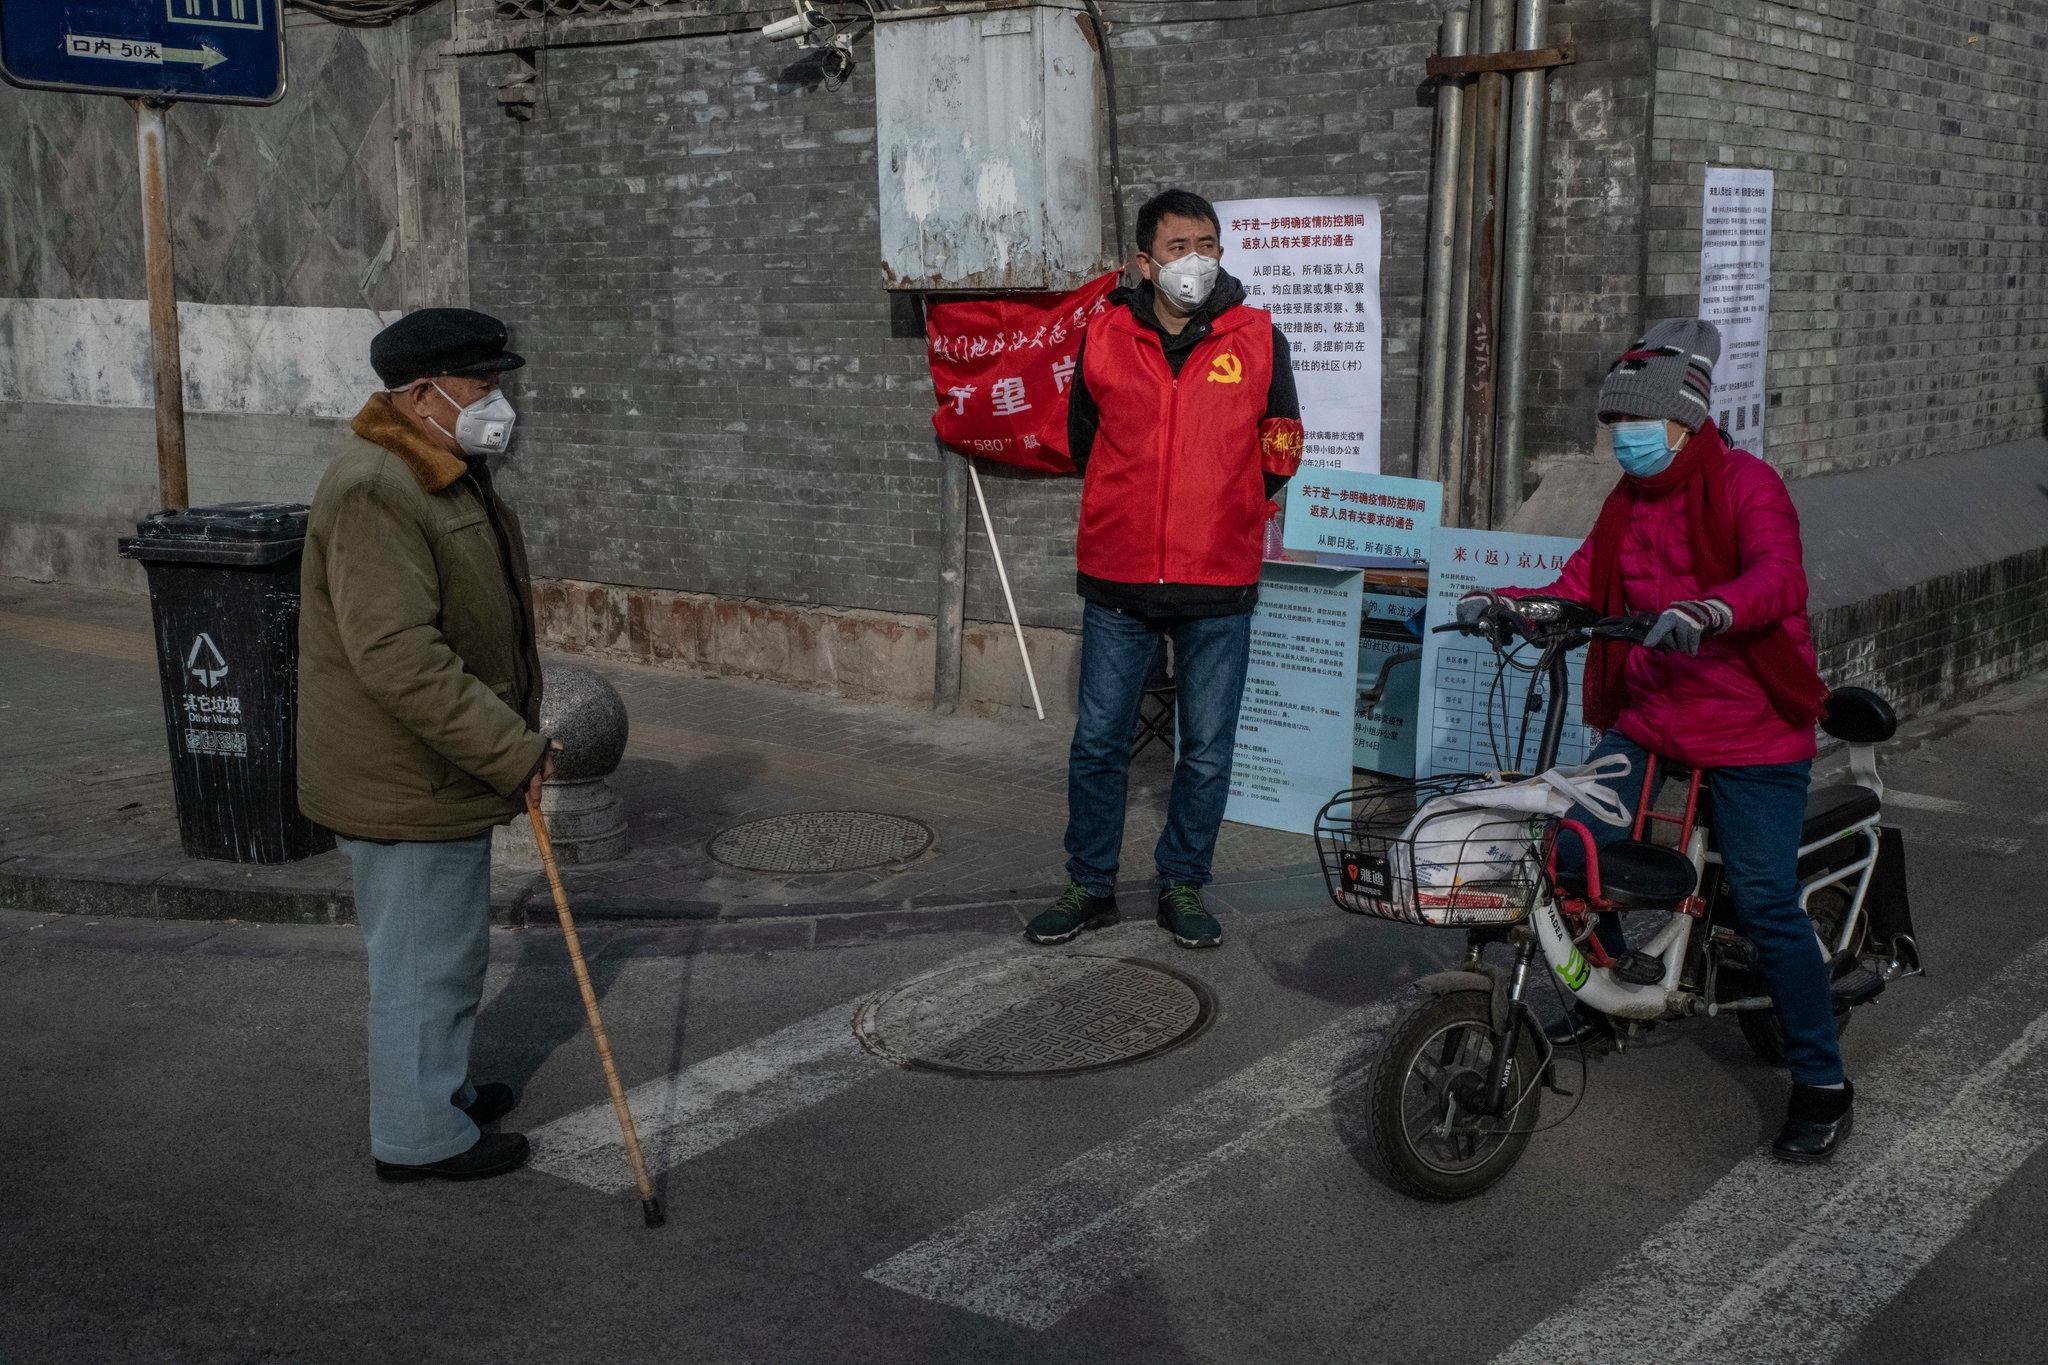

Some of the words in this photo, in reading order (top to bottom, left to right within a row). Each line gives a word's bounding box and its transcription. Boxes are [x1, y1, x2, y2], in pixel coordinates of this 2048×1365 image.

[73, 40, 111, 54] 口内
[120, 43, 161, 60] 50米
[1231, 214, 1365, 232] 关于进一步明确疫情防控期间
[1241, 233, 1355, 250] 返京人员有关要求的通告
[1252, 262, 1365, 277] 从即日起，所有返京人员
[1244, 302, 1365, 316] 拒绝接受居家观察、集
[1289, 340, 1366, 352] 前，须提前向在
[1302, 484, 1426, 512] 关于进一步明确疫情防控期间
[1310, 504, 1414, 531] 返京人员有关要求的通告
[1318, 534, 1422, 559] 从即日起，所有返京人员
[183, 694, 241, 714] 其它垃圾
[189, 712, 211, 723] Other
[212, 714, 239, 725] Waste
[1361, 868, 1385, 886] 雅迪
[1547, 906, 1564, 942] YADEA
[1501, 1058, 1513, 1088] YADEA
